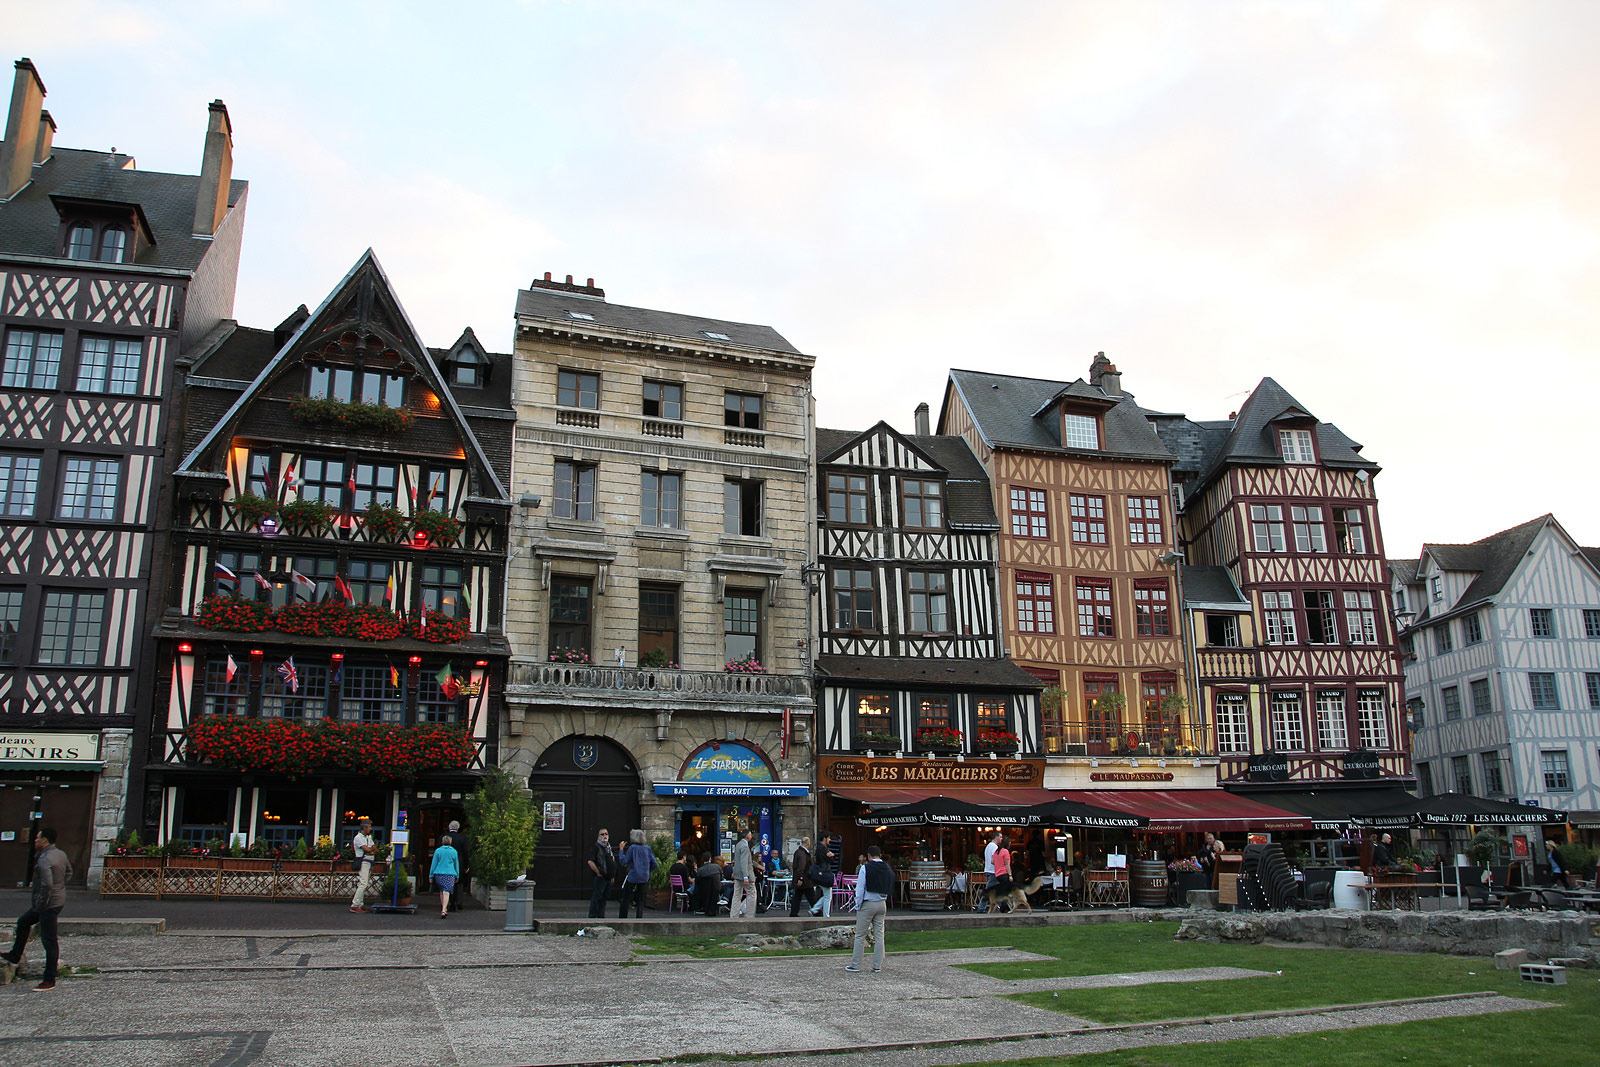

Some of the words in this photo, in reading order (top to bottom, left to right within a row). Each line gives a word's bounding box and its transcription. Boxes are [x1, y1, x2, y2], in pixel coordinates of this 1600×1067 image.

[0, 747, 79, 758] ENIRS
[711, 759, 752, 770] STARDUST
[871, 767, 898, 780] LES
[903, 767, 998, 780] MARAICHERS
[673, 787, 688, 795] BAR
[706, 787, 715, 795] LE
[716, 787, 752, 795] STARDUST
[1066, 815, 1082, 824] LES
[1085, 816, 1139, 827] MARAICHERS
[1426, 814, 1449, 823] Depuis
[1451, 814, 1467, 822] 1912
[1474, 814, 1490, 822] LES
[1490, 814, 1548, 822] MARAICHERS
